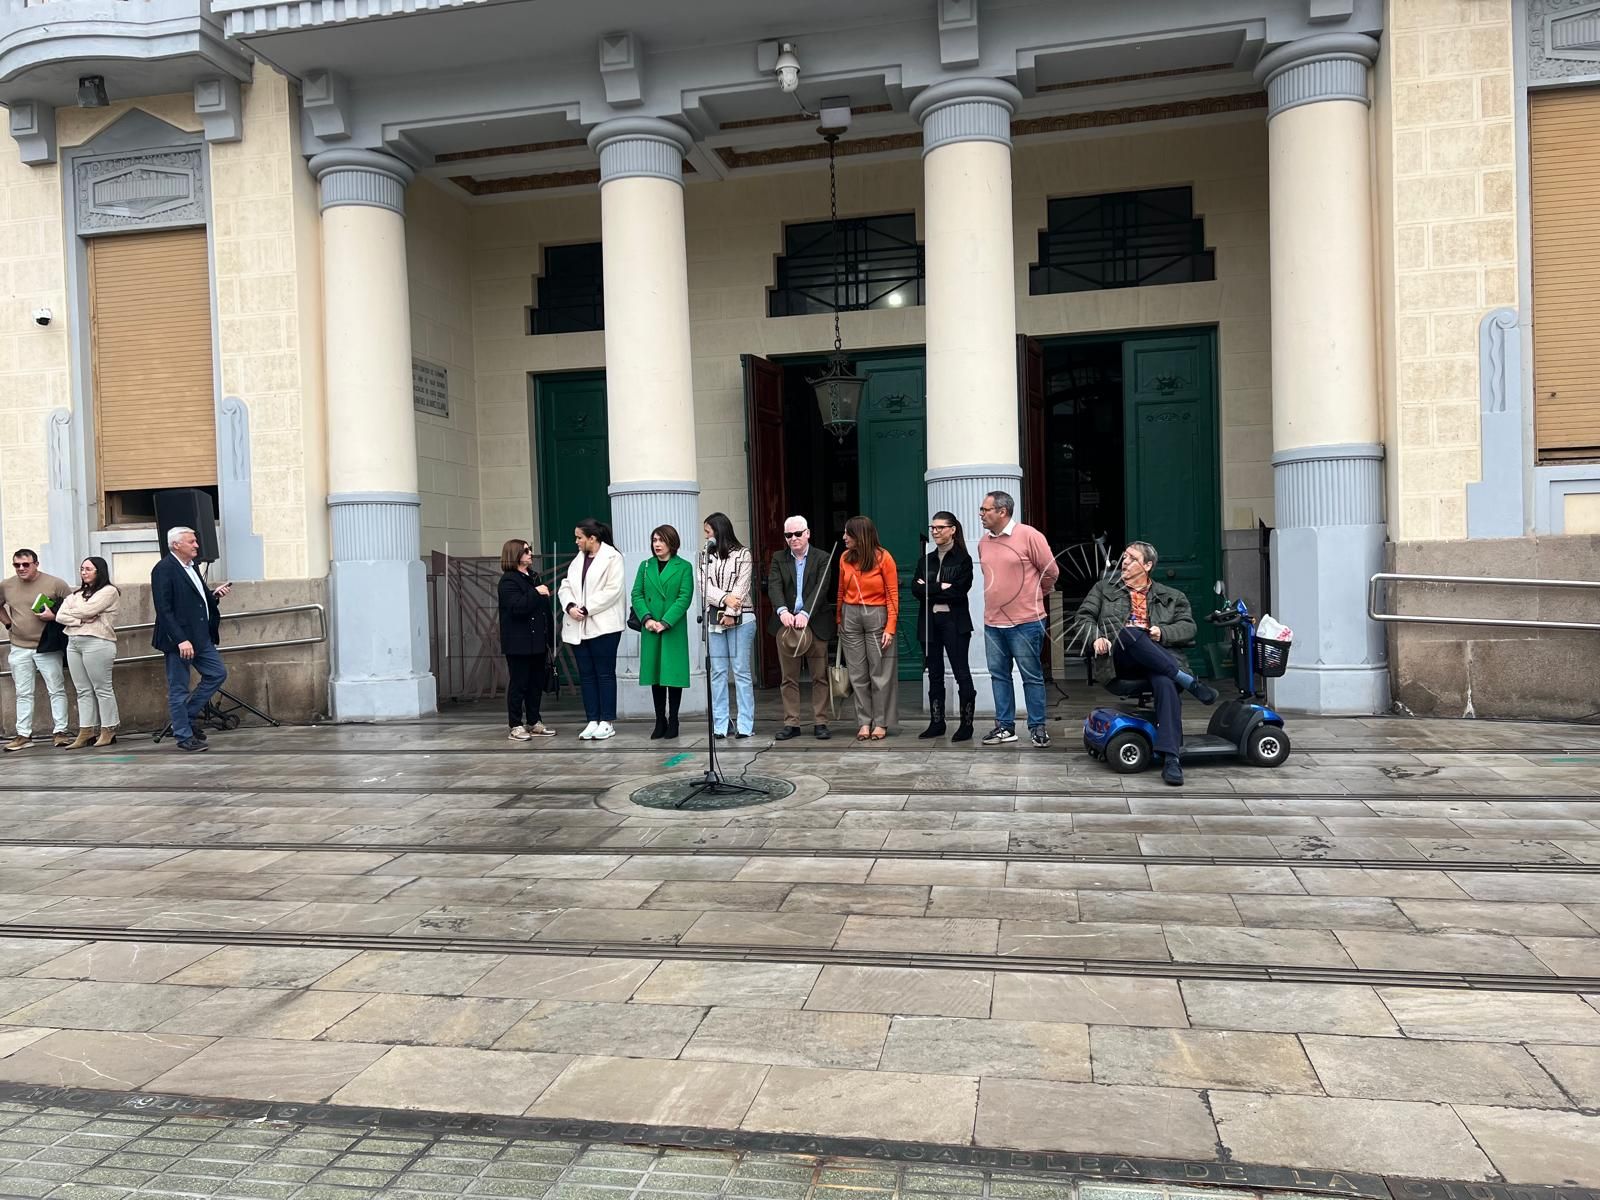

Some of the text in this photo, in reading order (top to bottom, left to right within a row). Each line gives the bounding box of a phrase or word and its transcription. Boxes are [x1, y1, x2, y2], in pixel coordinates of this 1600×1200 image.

[357, 1111, 382, 1124] A
[417, 1116, 500, 1131] SER
[530, 1123, 649, 1140] SEDE
[681, 1129, 737, 1146] DE
[770, 1138, 824, 1153] LA
[865, 1143, 1140, 1174] ASAMBLEA
[1184, 1163, 1247, 1181] DE
[1291, 1170, 1359, 1190] LA
